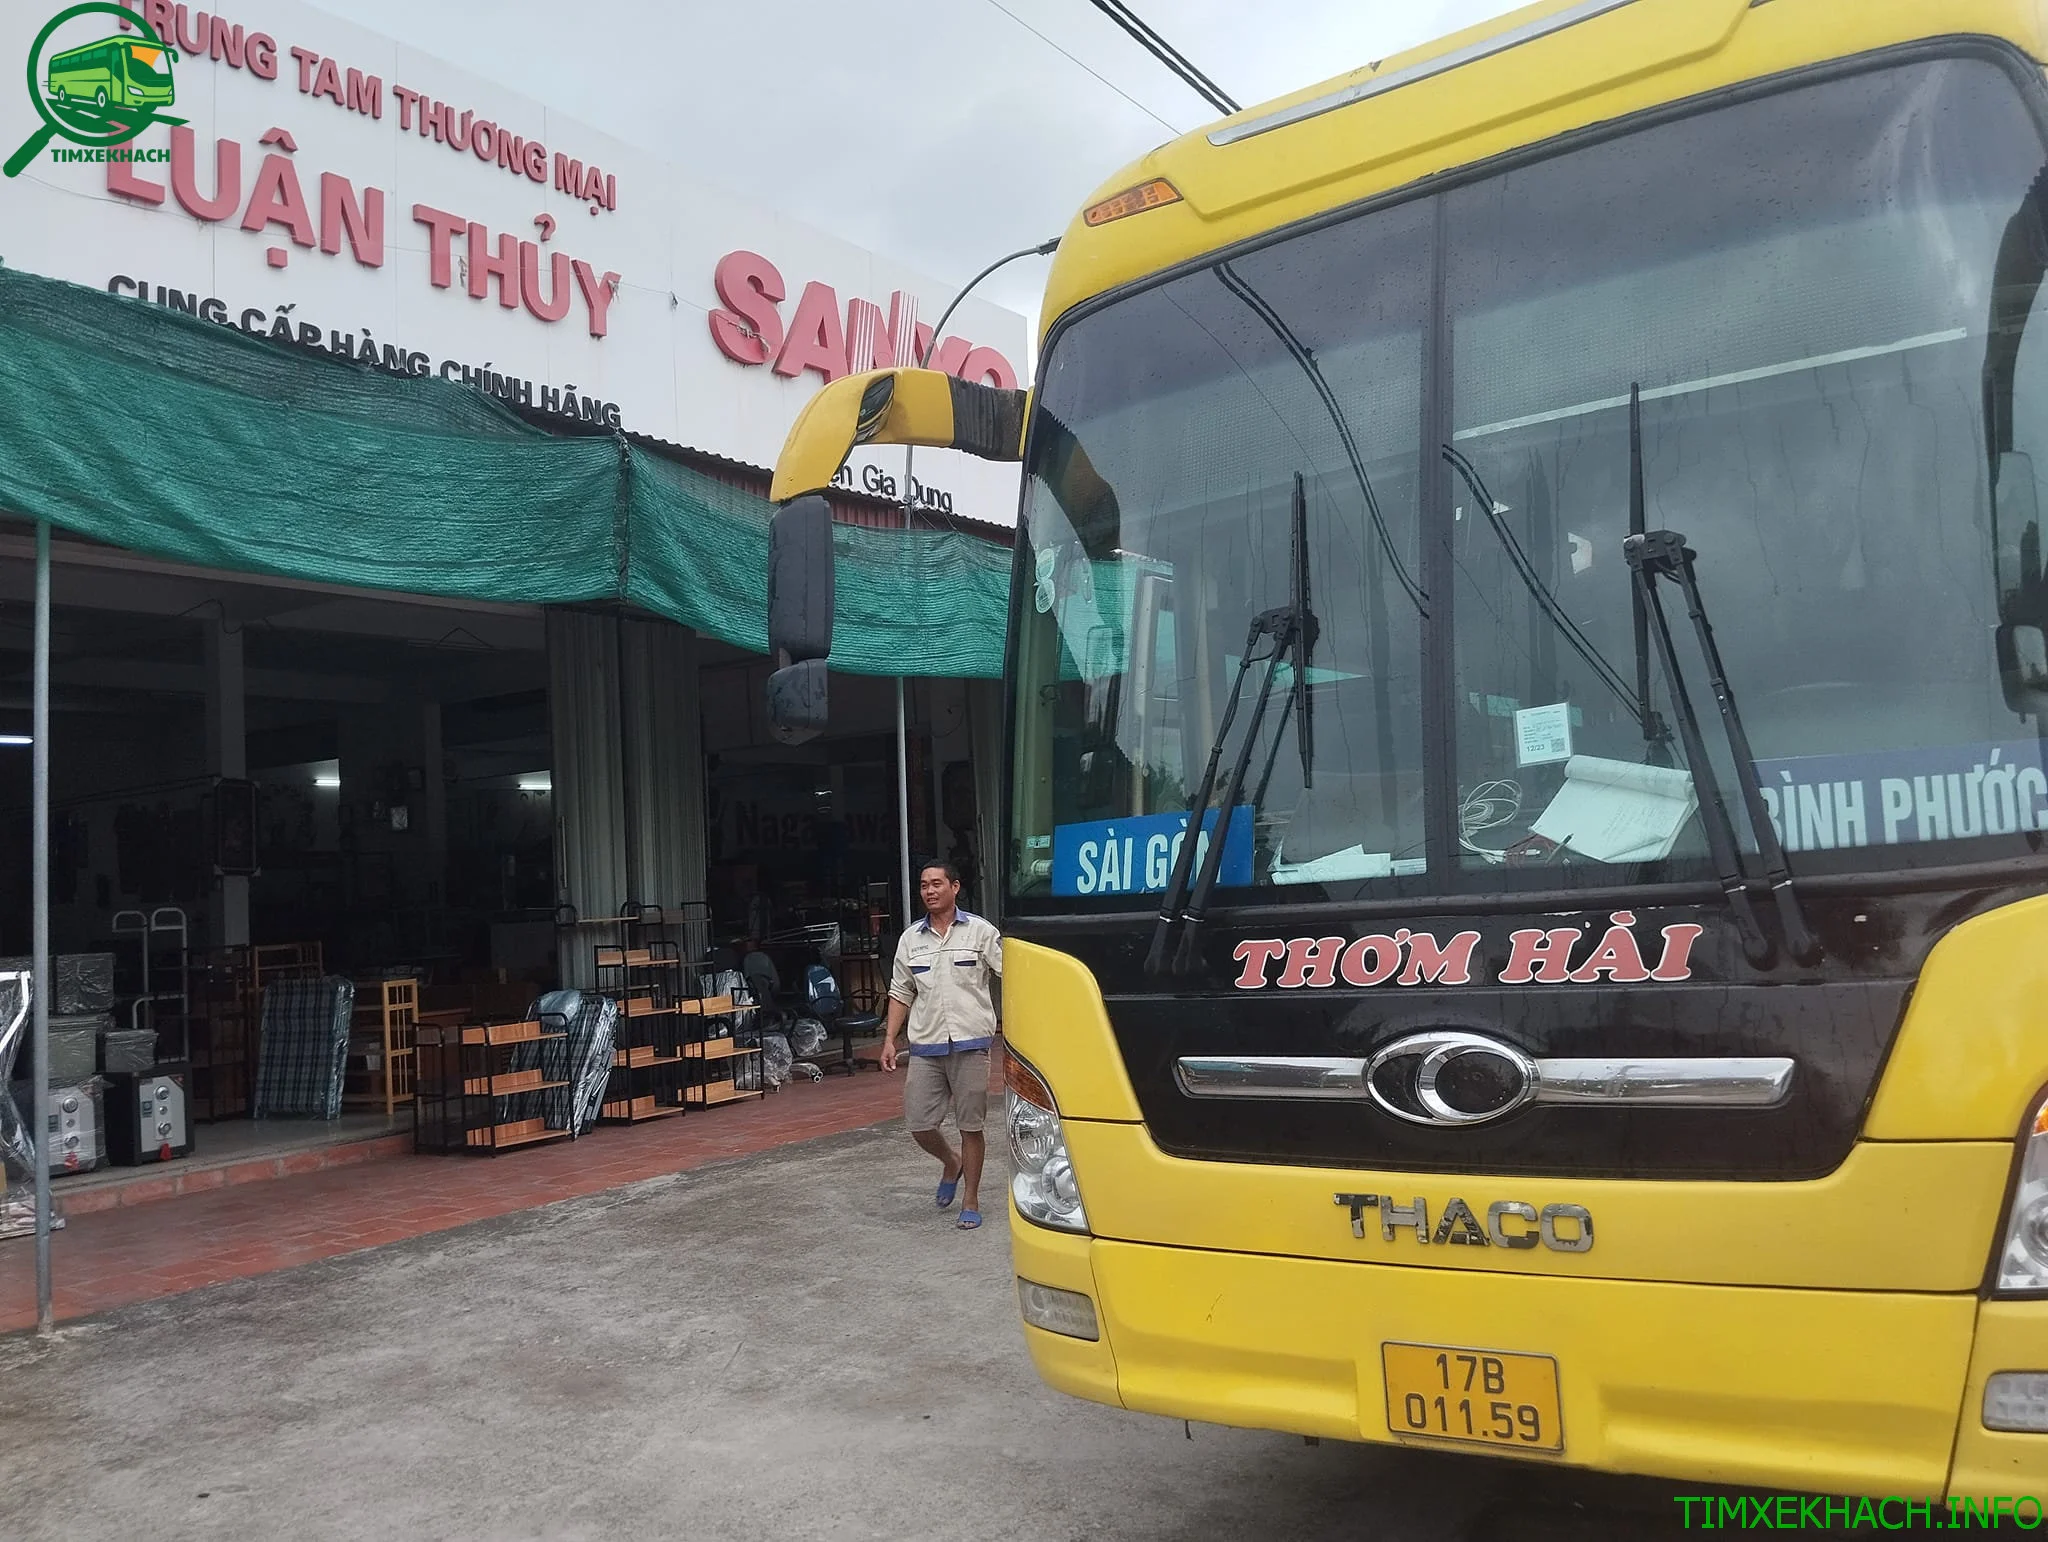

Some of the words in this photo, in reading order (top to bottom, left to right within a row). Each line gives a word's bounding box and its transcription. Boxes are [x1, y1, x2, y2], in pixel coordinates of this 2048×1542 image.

[291, 46, 382, 119] TAM
[393, 85, 548, 183] THƯƠNG
[555, 152, 616, 215] MẠI
[106, 121, 384, 268] LUẬN
[413, 204, 620, 337] THỦY
[331, 328, 430, 376] HÀNG
[440, 362, 532, 404] CHÍNH
[541, 384, 621, 428] HÃNG
[863, 464, 896, 496] Gia
[735, 800, 895, 849] Nagaawa
[1881, 748, 2048, 843] PHƯỚC
[1077, 828, 1133, 894] SÀI
[1233, 928, 1481, 989] THƠM
[1334, 1192, 1594, 1252] THACO
[1436, 1353, 1505, 1394] 17B
[1405, 1393, 1540, 1442] 011.59
